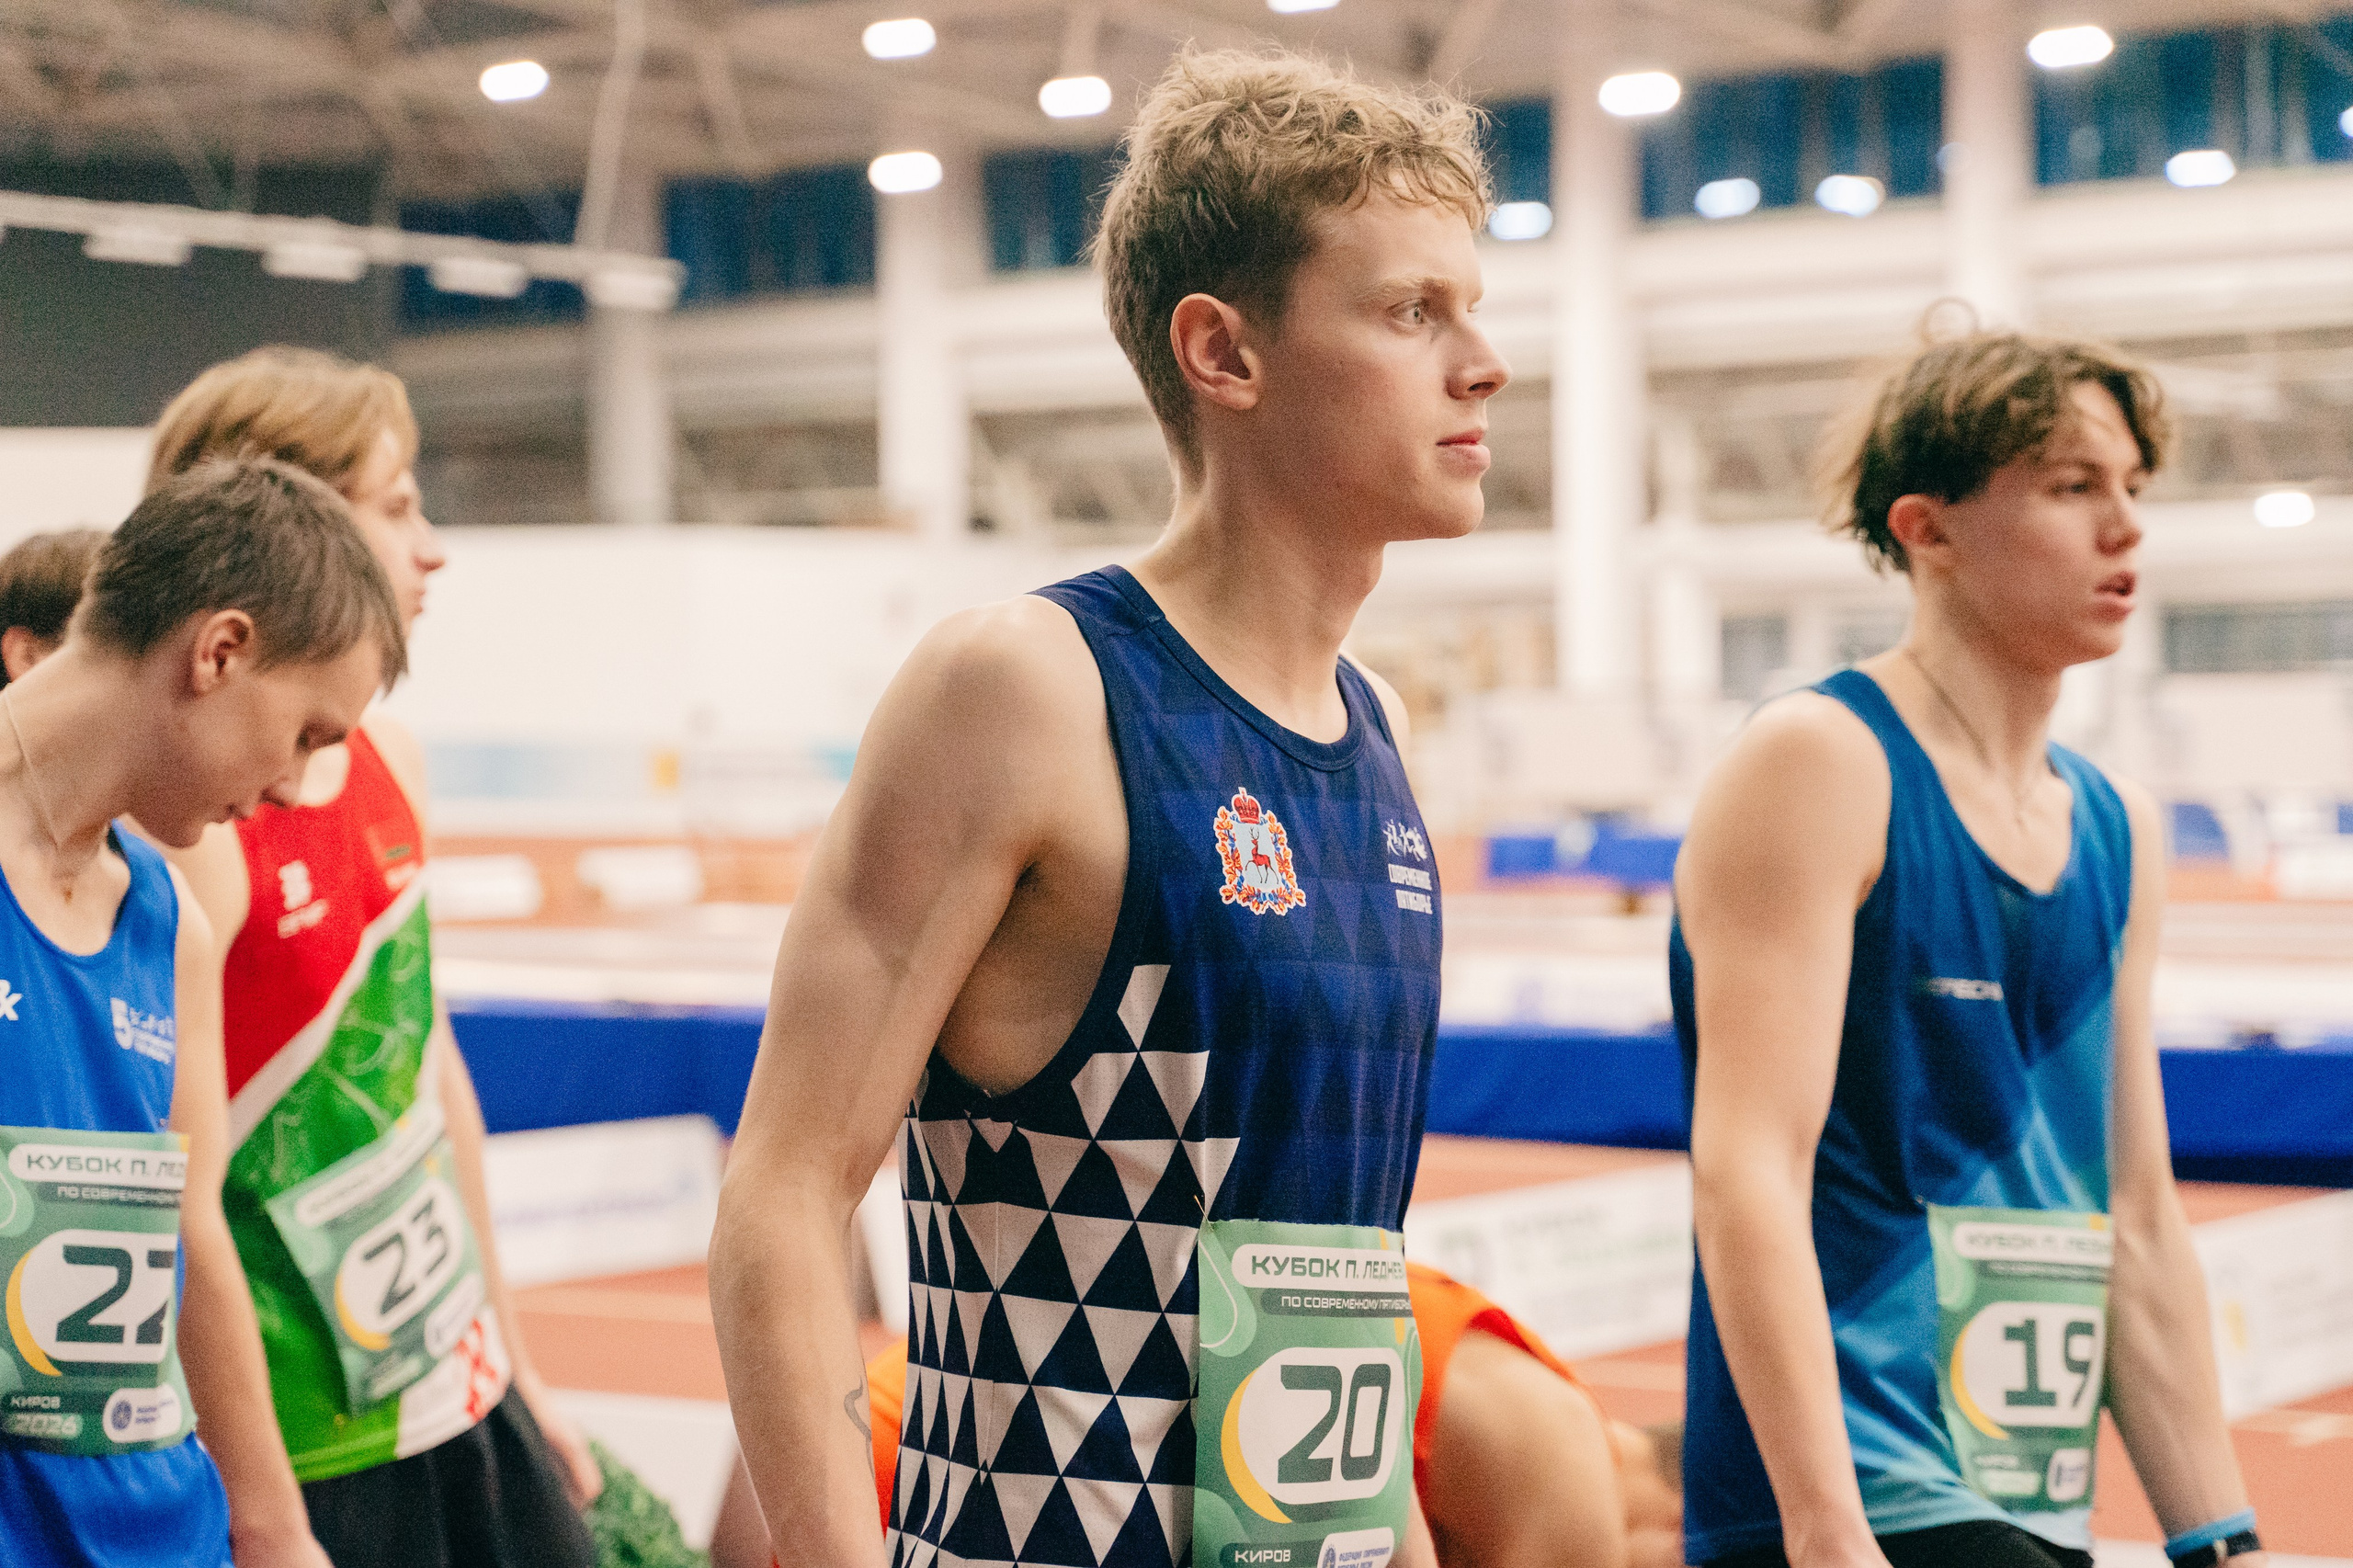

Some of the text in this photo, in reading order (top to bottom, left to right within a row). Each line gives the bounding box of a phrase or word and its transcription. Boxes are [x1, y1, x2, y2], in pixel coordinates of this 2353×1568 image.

[27, 1154, 122, 1174] КУБОК
[57, 1186, 79, 1199] ПО
[363, 1197, 449, 1317] 23
[1251, 1256, 1340, 1278] КУБОК
[1345, 1259, 1360, 1279] П.
[1281, 1296, 1302, 1308] ПО
[1303, 1296, 1380, 1311] СОВРЕМЕННОМУ
[2004, 1318, 2096, 1408] 19
[10, 1395, 62, 1410] КИРОВ
[1278, 1363, 1392, 1484] 20
[1234, 1549, 1291, 1563] КИРОВ
